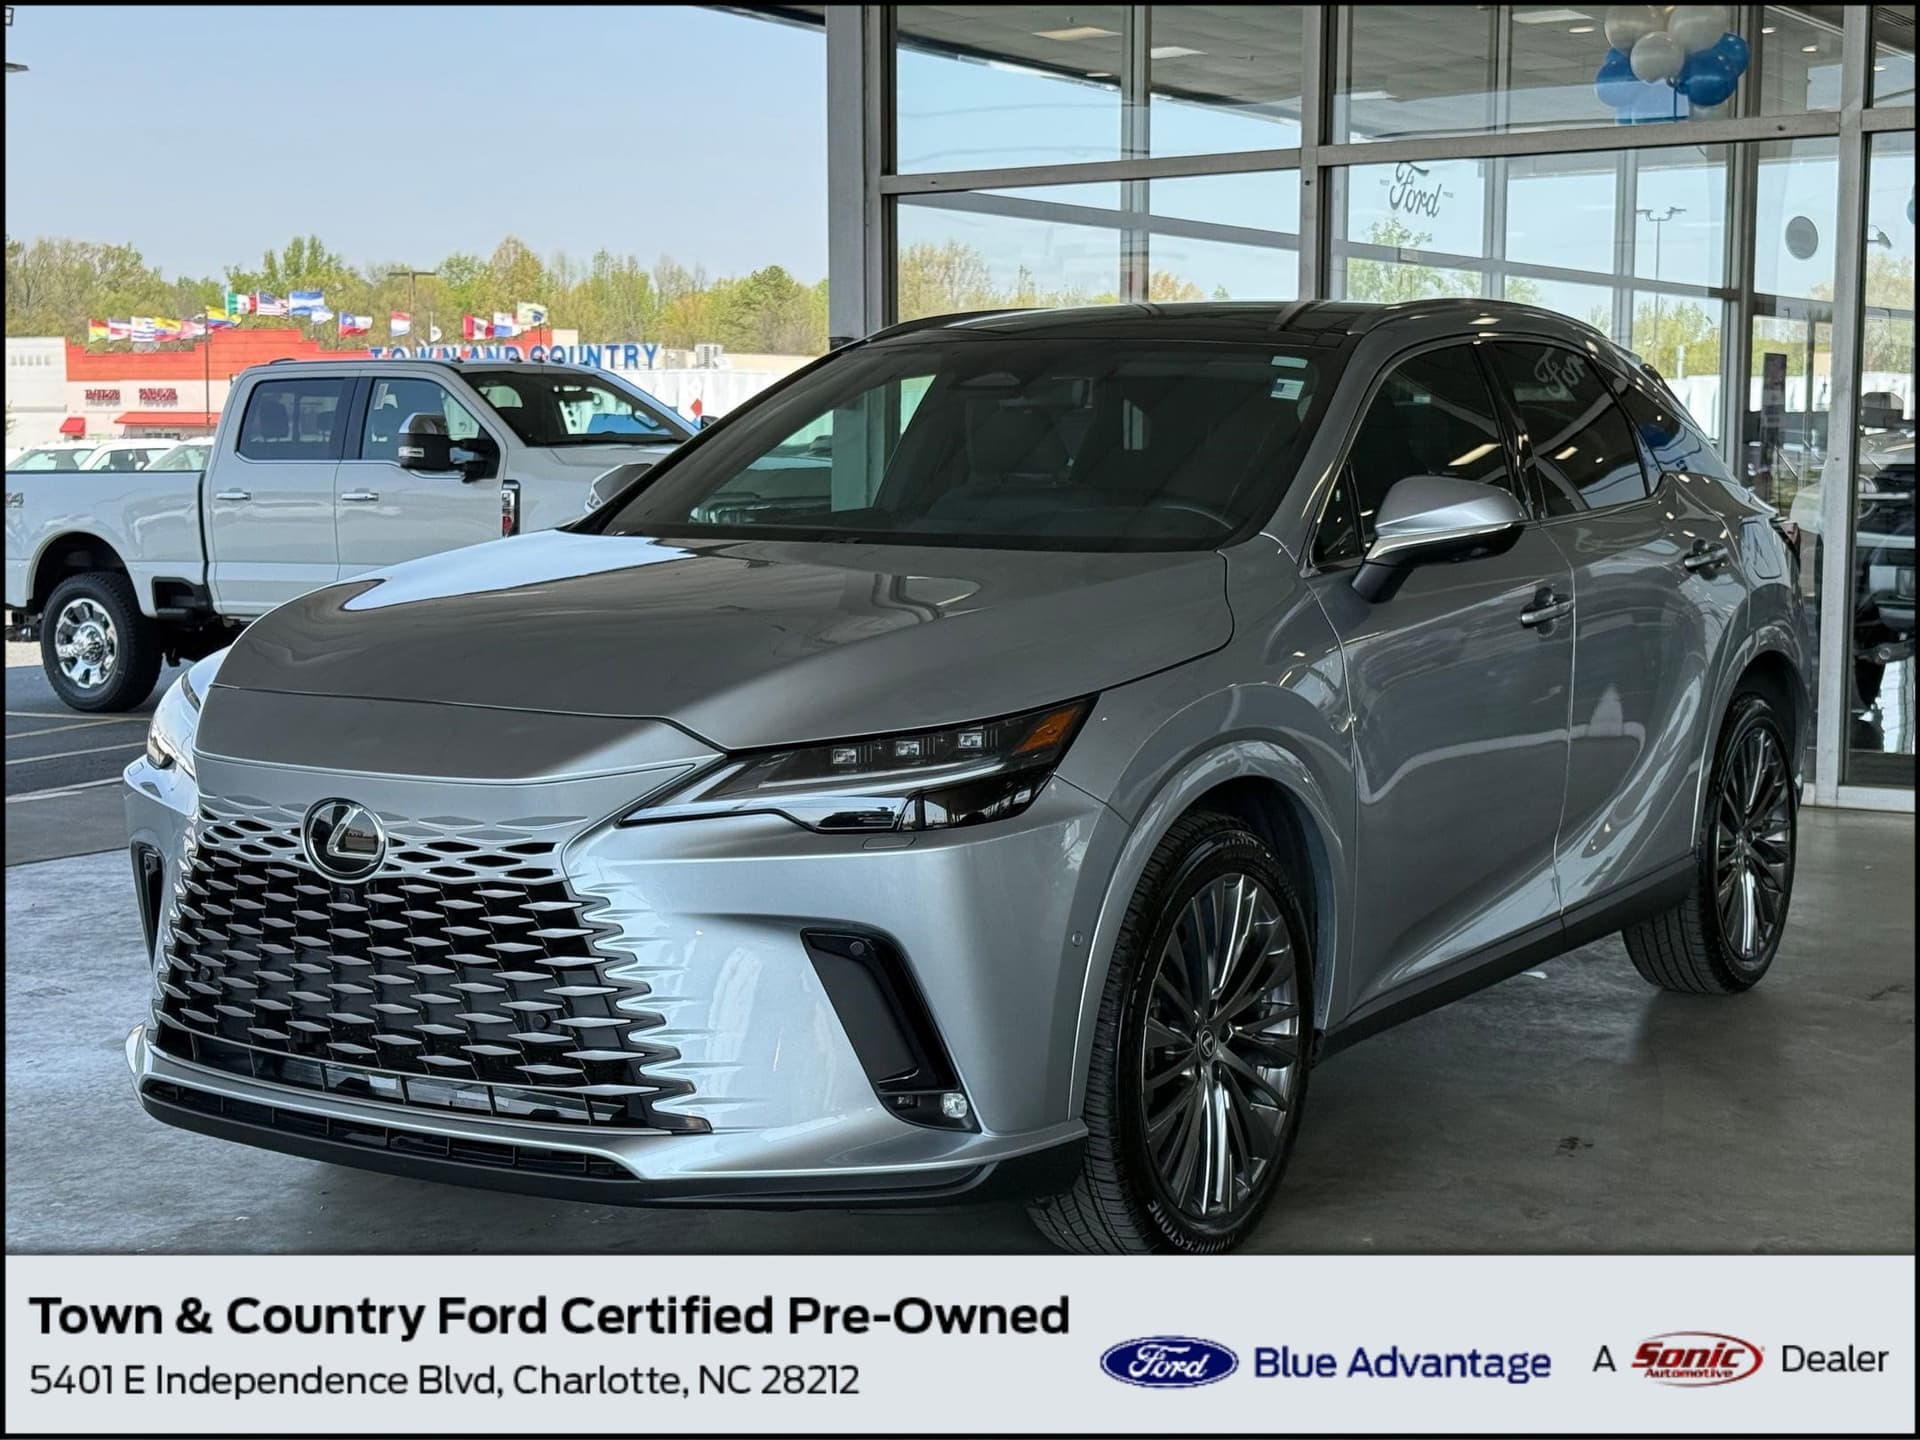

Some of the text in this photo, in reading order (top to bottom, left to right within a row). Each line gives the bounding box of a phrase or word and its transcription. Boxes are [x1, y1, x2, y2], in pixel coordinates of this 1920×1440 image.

[1388, 161, 1442, 218] Ford
[370, 344, 659, 369] TOWN AND COUNTRY
